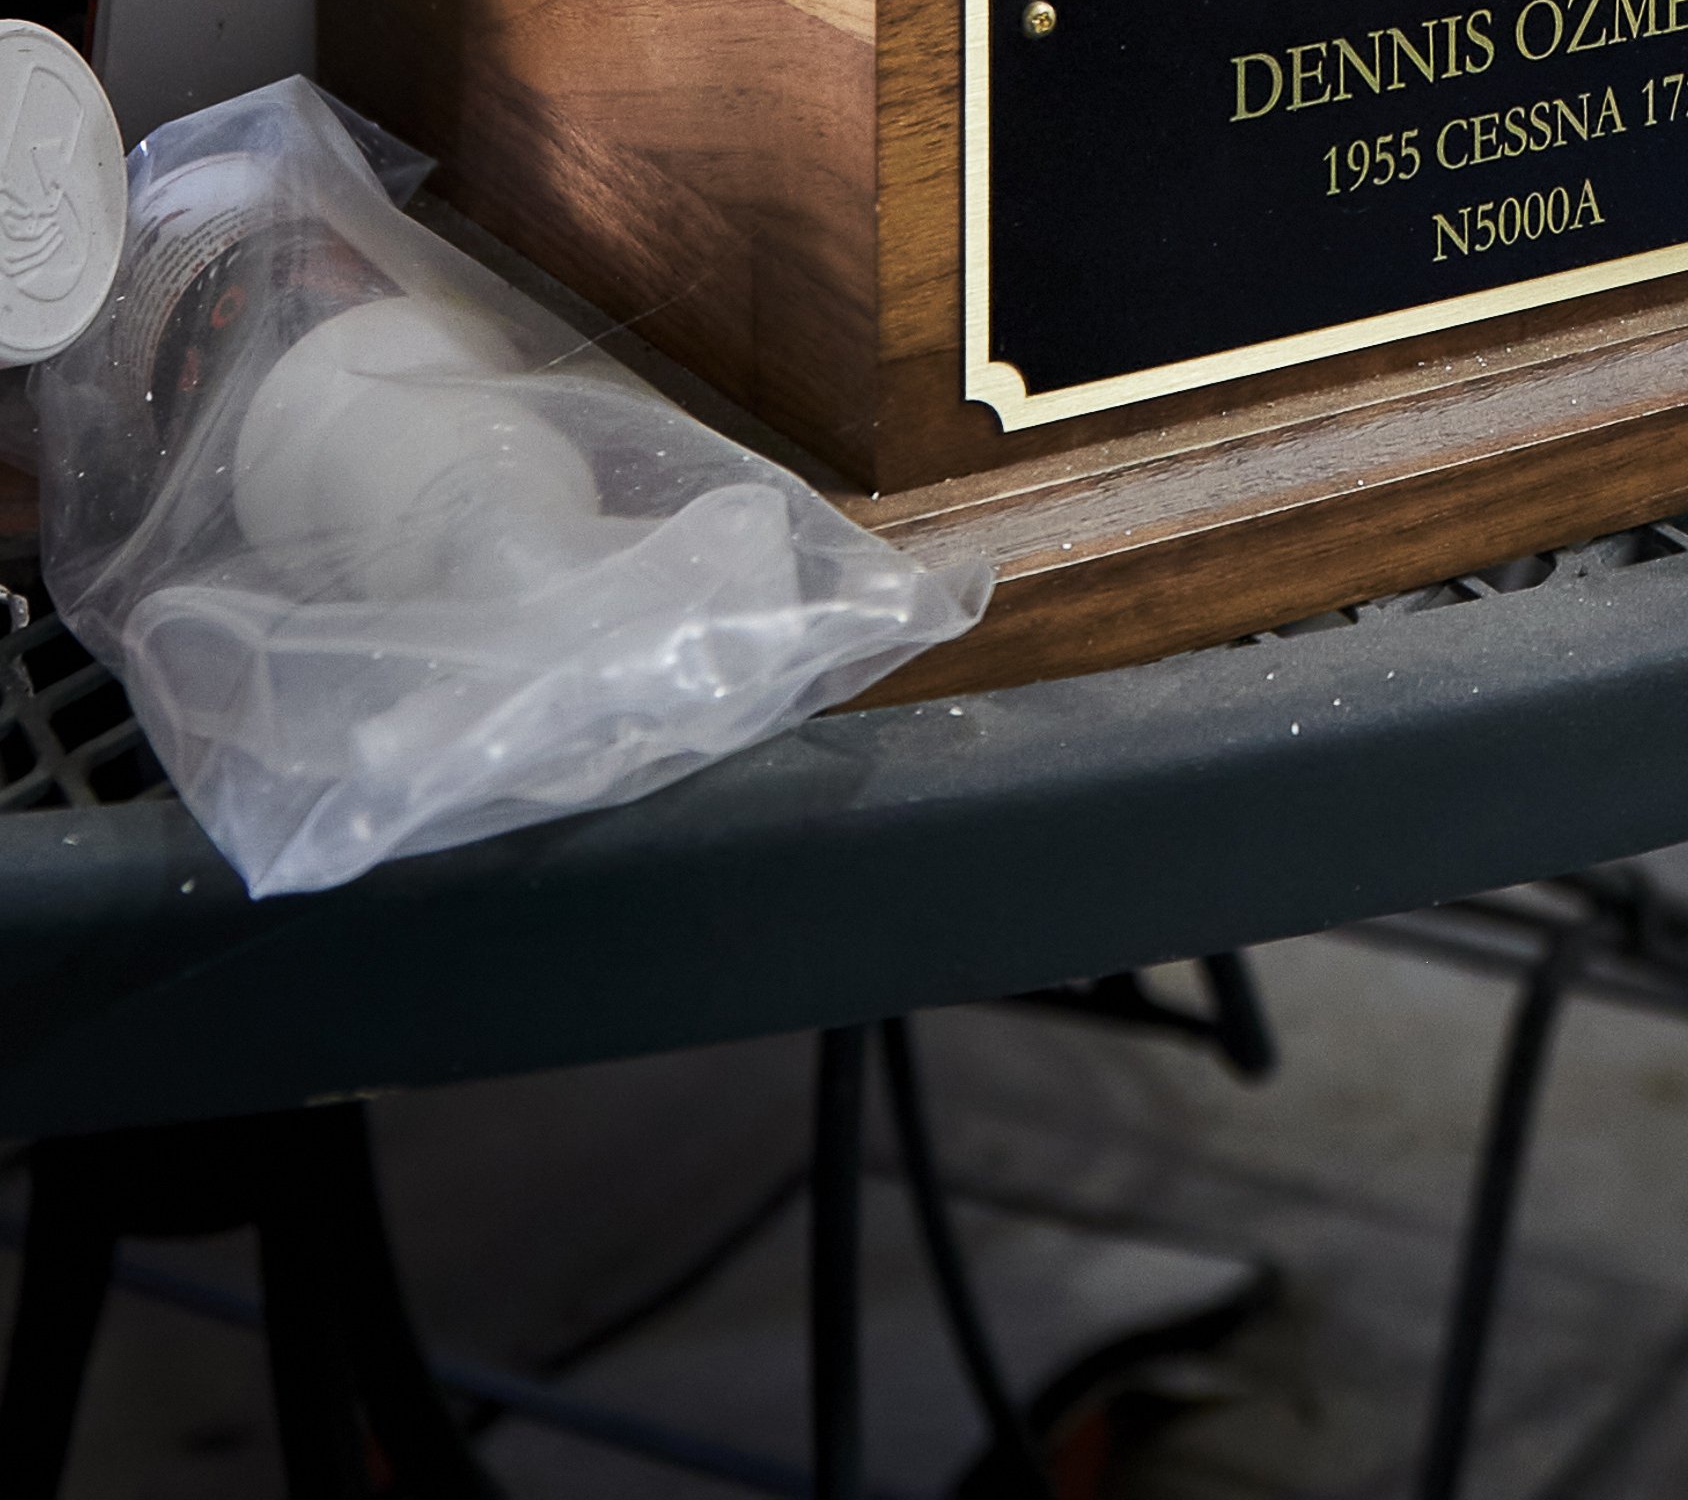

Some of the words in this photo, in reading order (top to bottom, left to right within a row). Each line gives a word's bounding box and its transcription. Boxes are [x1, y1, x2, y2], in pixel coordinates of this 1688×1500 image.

[1231, 10, 1494, 121] DENNIS
[1324, 129, 1420, 195] 1955
[1437, 87, 1626, 169] CESSNA
[1433, 180, 1605, 261] N5000A
